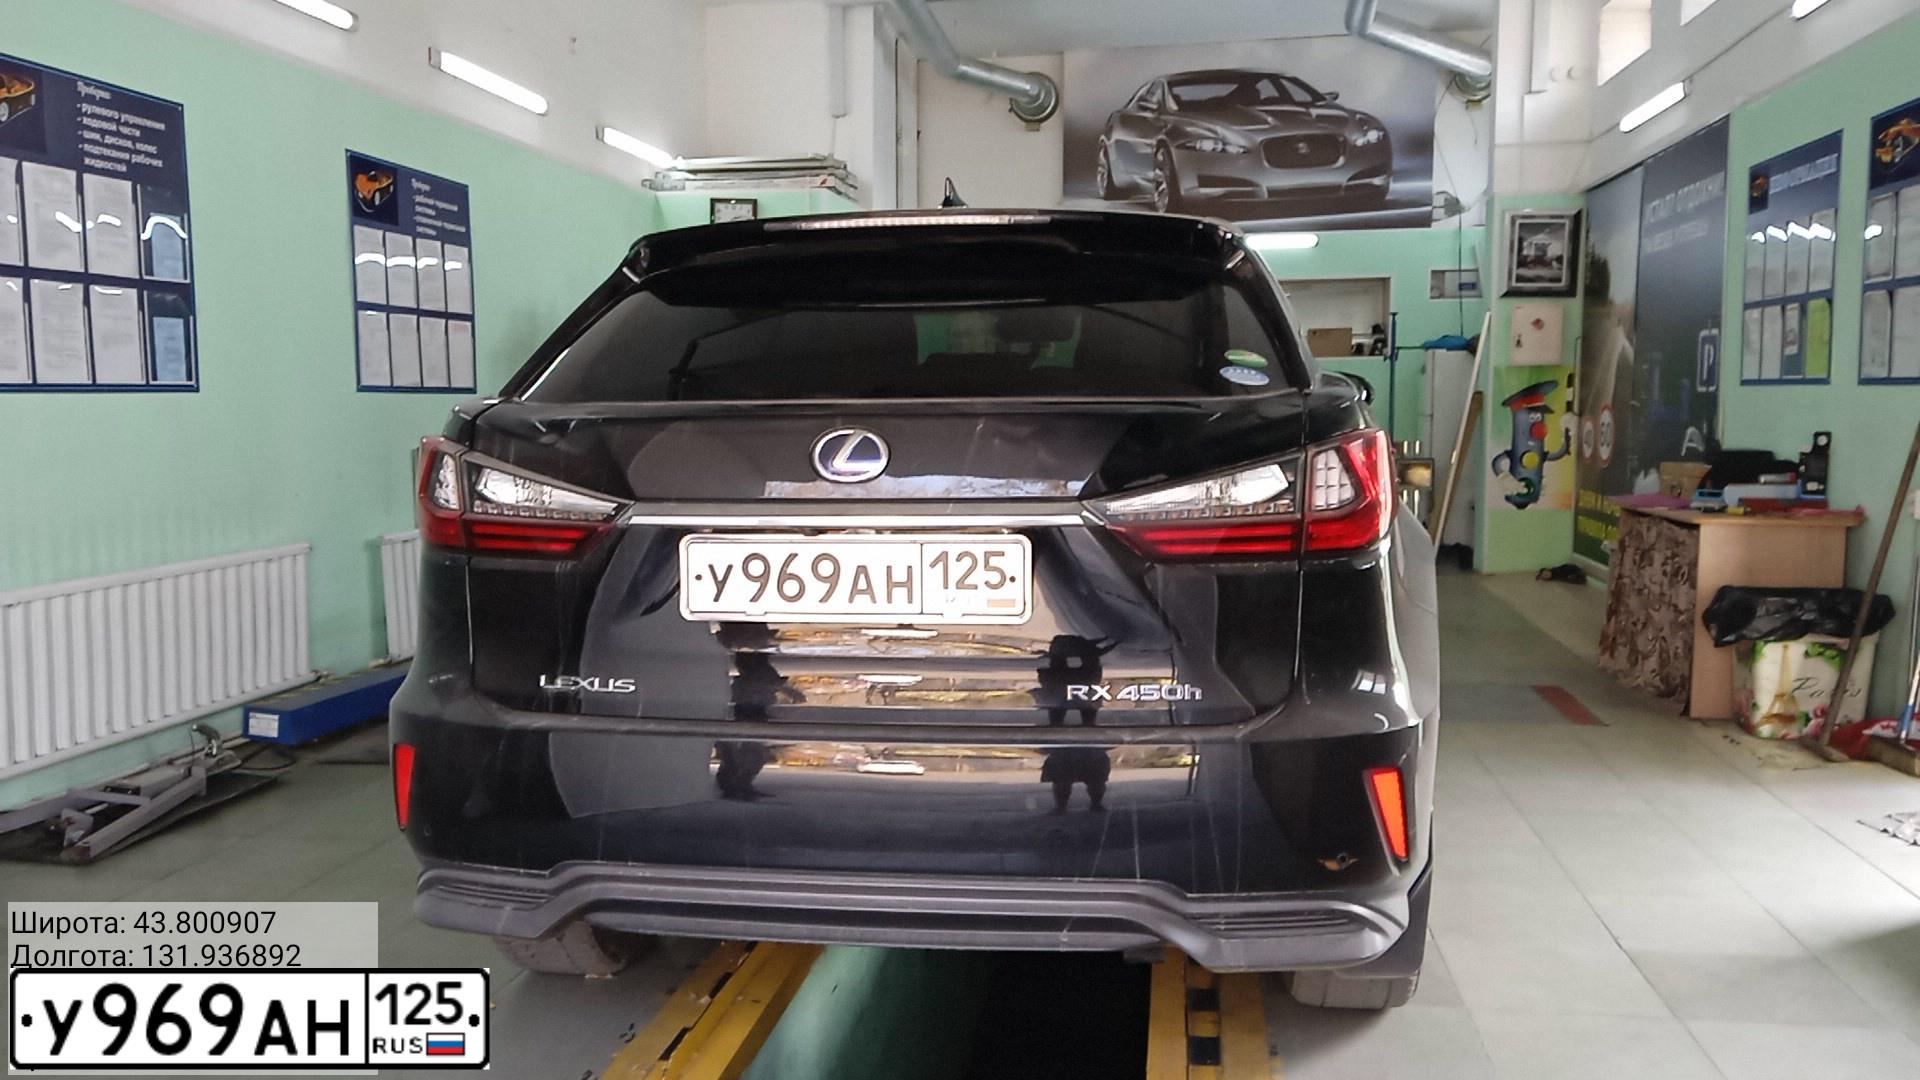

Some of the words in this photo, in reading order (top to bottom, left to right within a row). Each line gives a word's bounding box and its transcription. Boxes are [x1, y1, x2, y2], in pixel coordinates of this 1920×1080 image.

[929, 550, 1006, 590] 125
[540, 674, 636, 693] LEXUS
[1067, 684, 1112, 701] RX
[1116, 683, 1203, 701] 450h
[1791, 676, 1862, 698] Pais
